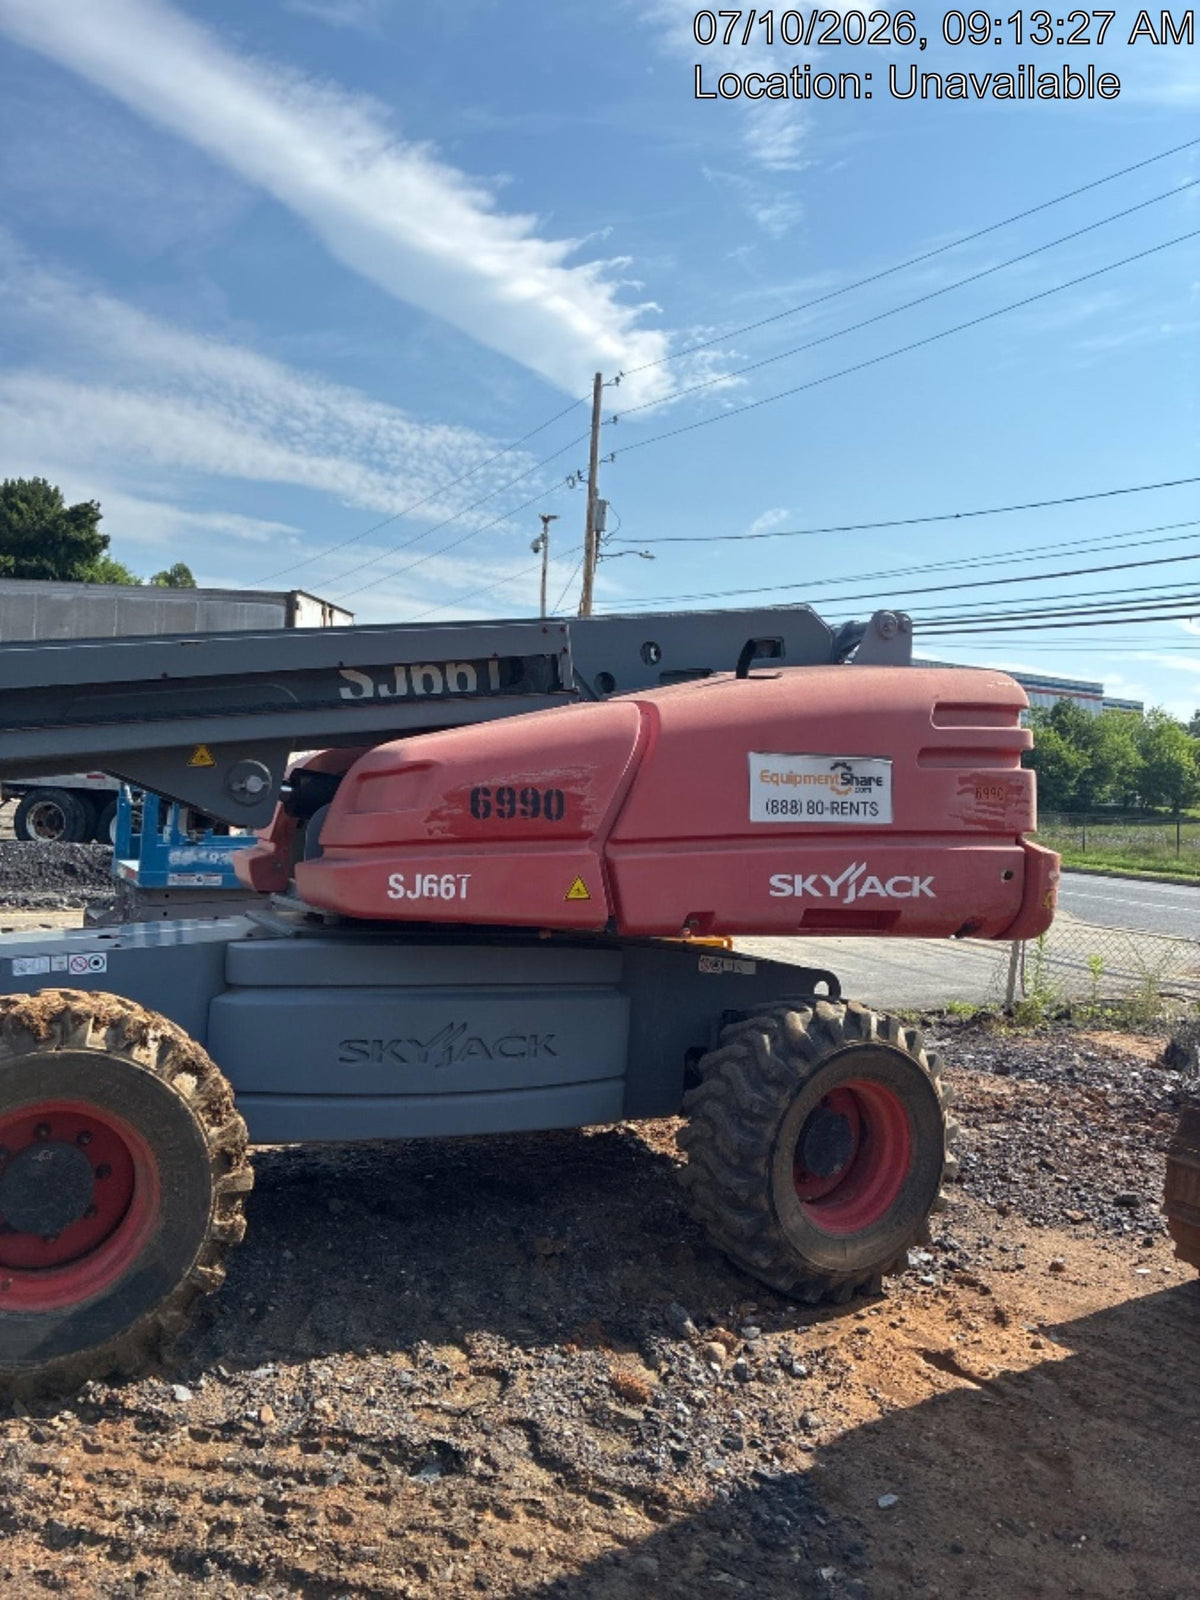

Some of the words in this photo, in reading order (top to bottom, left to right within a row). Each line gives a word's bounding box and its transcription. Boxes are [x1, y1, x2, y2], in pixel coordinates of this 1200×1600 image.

[760, 769, 883, 788] EquipmentShare
[469, 786, 565, 822] 6990
[765, 798, 803, 817] (888)
[806, 800, 880, 817] 80-RENTS
[387, 873, 472, 901] SJ66T
[769, 862, 937, 904] SKYJACK
[338, 1021, 559, 1069] SKYJACK
